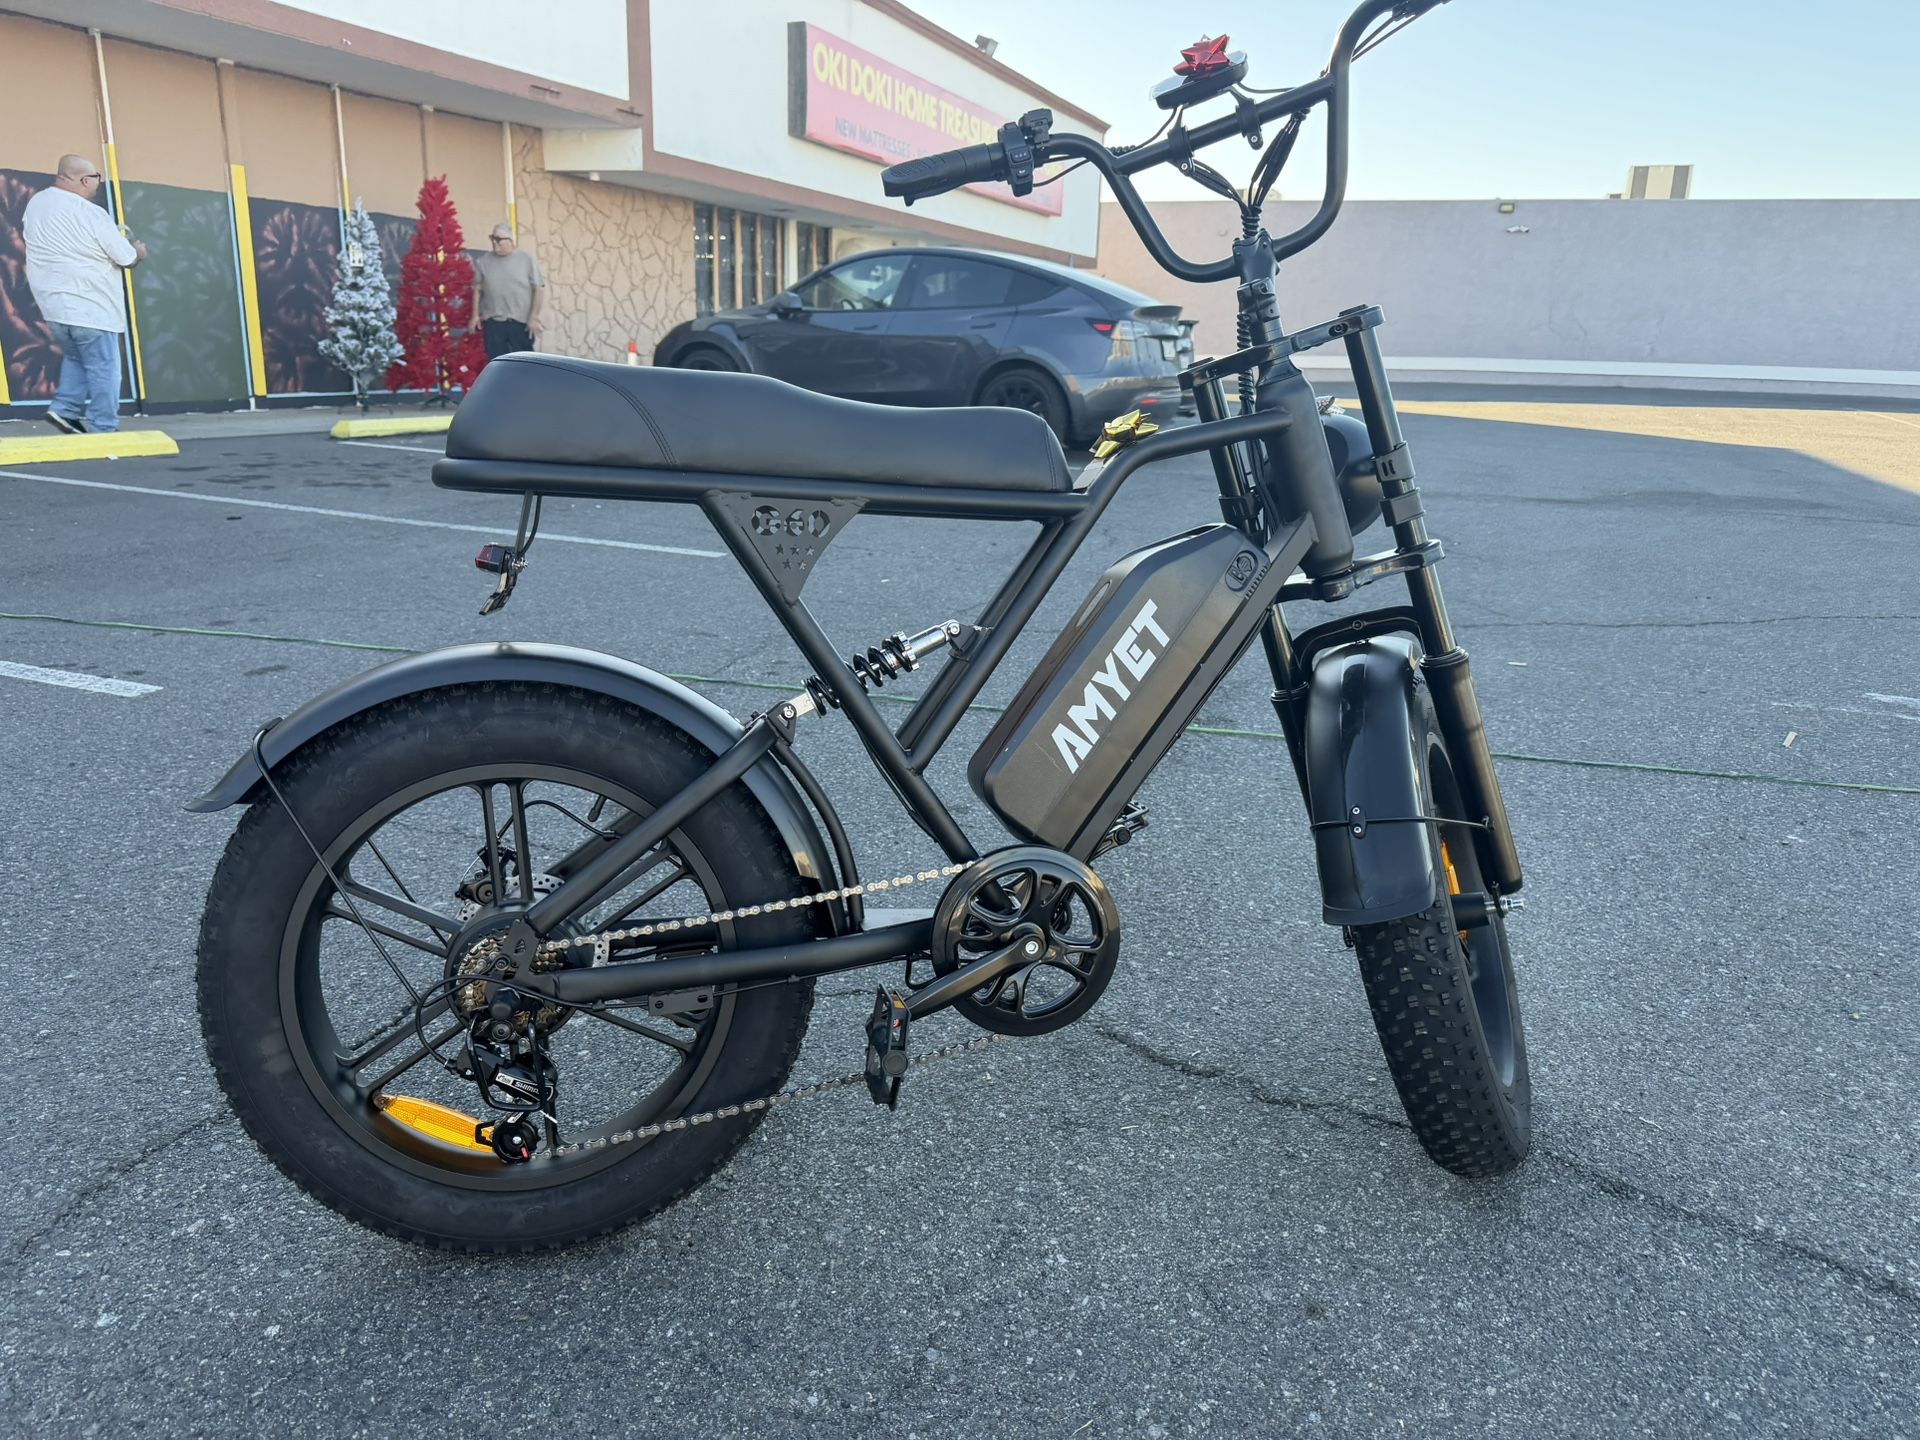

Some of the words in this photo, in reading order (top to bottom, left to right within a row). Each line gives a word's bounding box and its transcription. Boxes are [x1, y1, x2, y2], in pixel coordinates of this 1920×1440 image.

[813, 42, 848, 92] OKI
[851, 58, 892, 111] DOKI
[894, 79, 937, 129] HOME
[835, 117, 857, 140] NEW
[1051, 598, 1170, 774] AMYET
[514, 1081, 540, 1095] SHIMA
